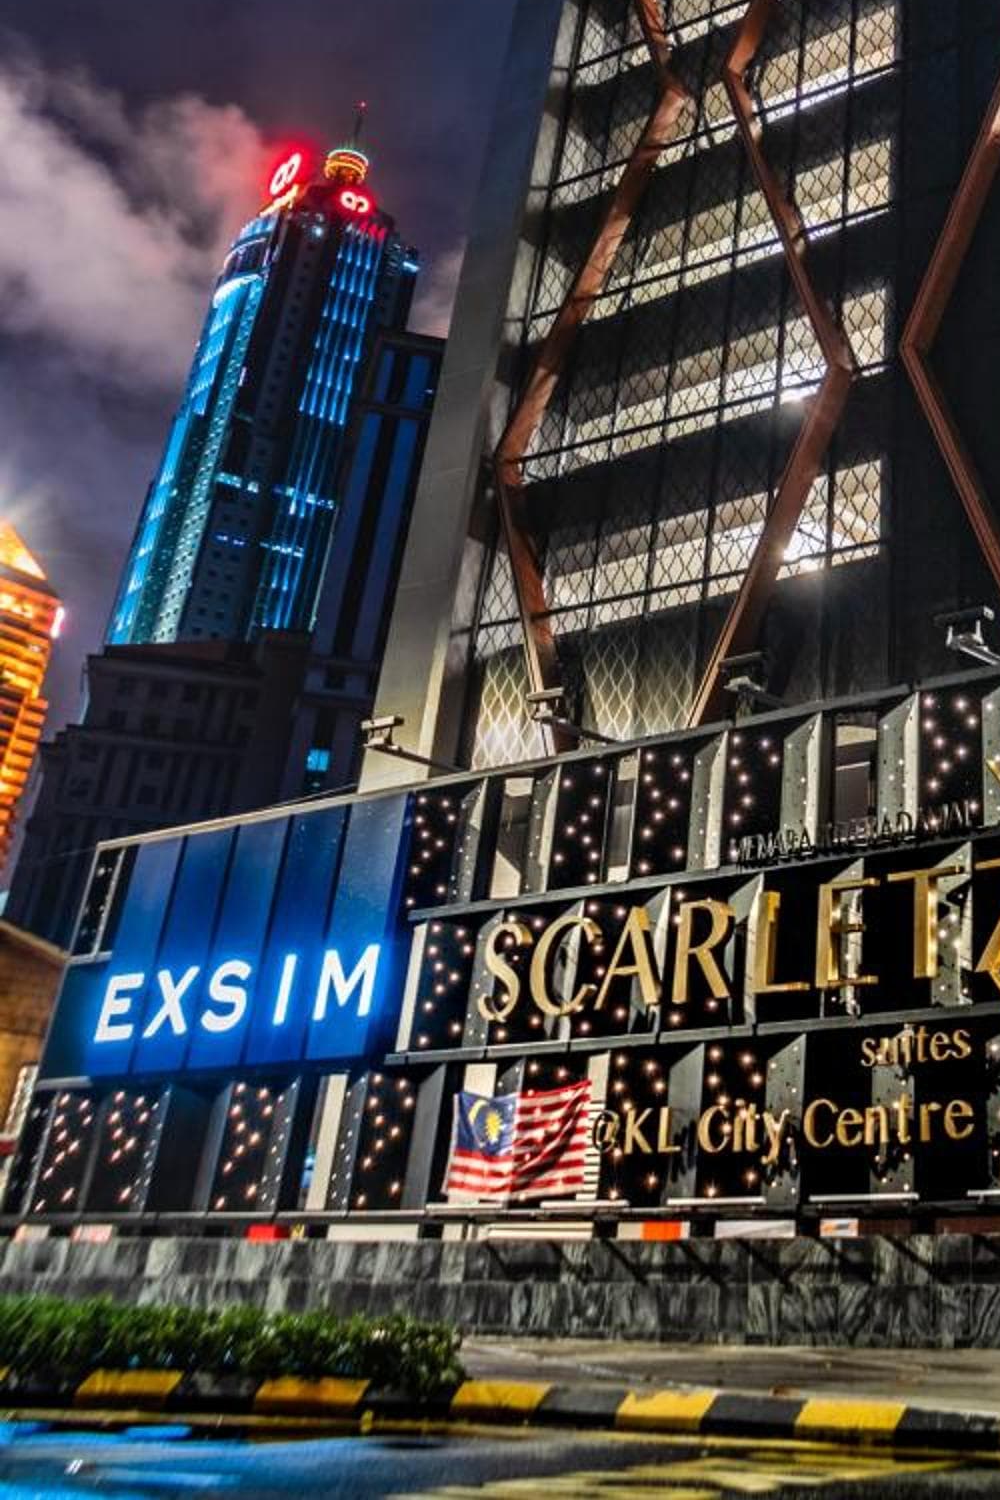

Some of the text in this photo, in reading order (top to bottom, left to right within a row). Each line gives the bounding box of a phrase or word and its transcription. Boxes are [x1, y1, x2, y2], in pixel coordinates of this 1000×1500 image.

[94, 943, 381, 1043] EXSIM
[860, 1024, 972, 1067] suites
[592, 1097, 974, 1165] @KL City Centre
